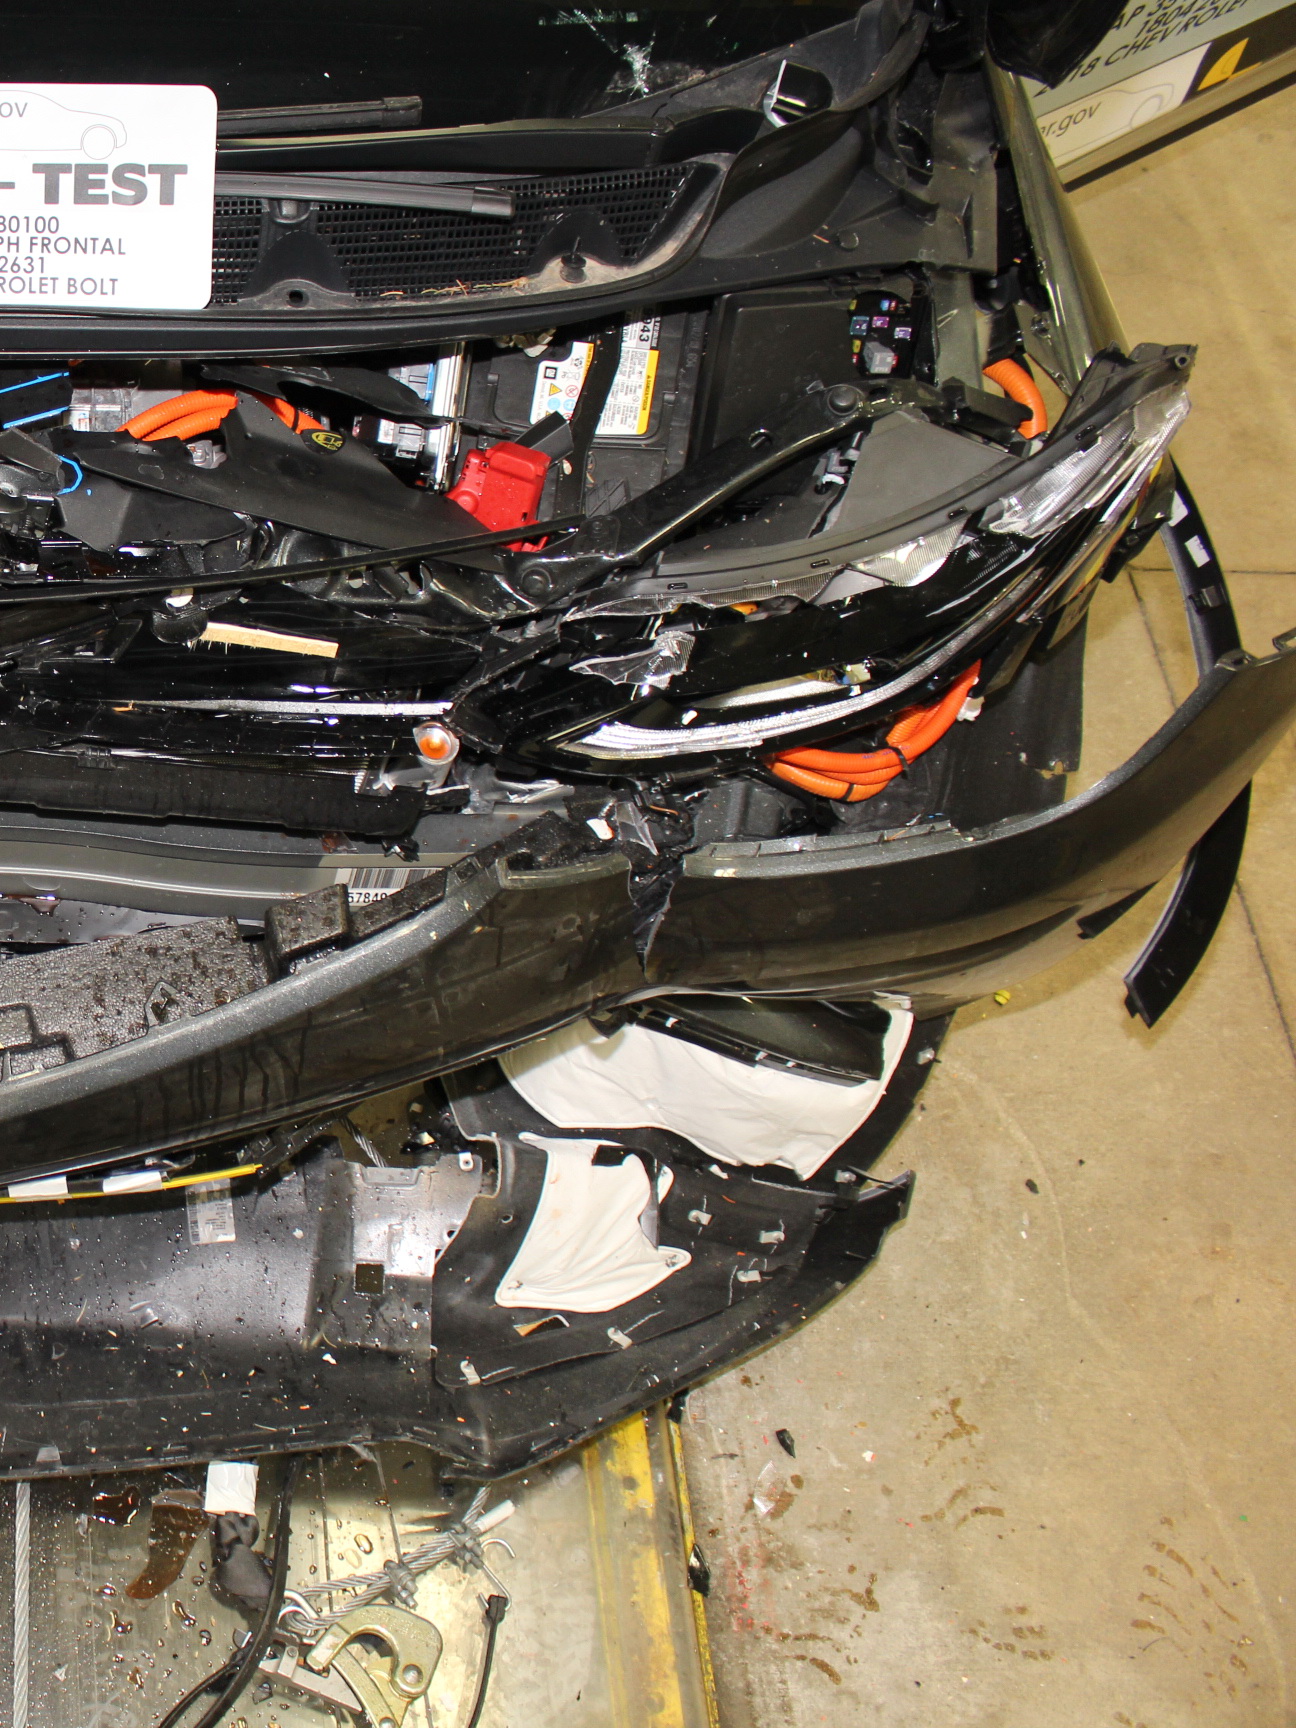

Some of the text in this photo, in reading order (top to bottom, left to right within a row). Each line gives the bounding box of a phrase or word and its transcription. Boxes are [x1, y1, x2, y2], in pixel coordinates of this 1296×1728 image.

[32, 163, 188, 206] TEST
[29, 236, 126, 255] FRONTAL
[67, 277, 118, 296] BOLT
